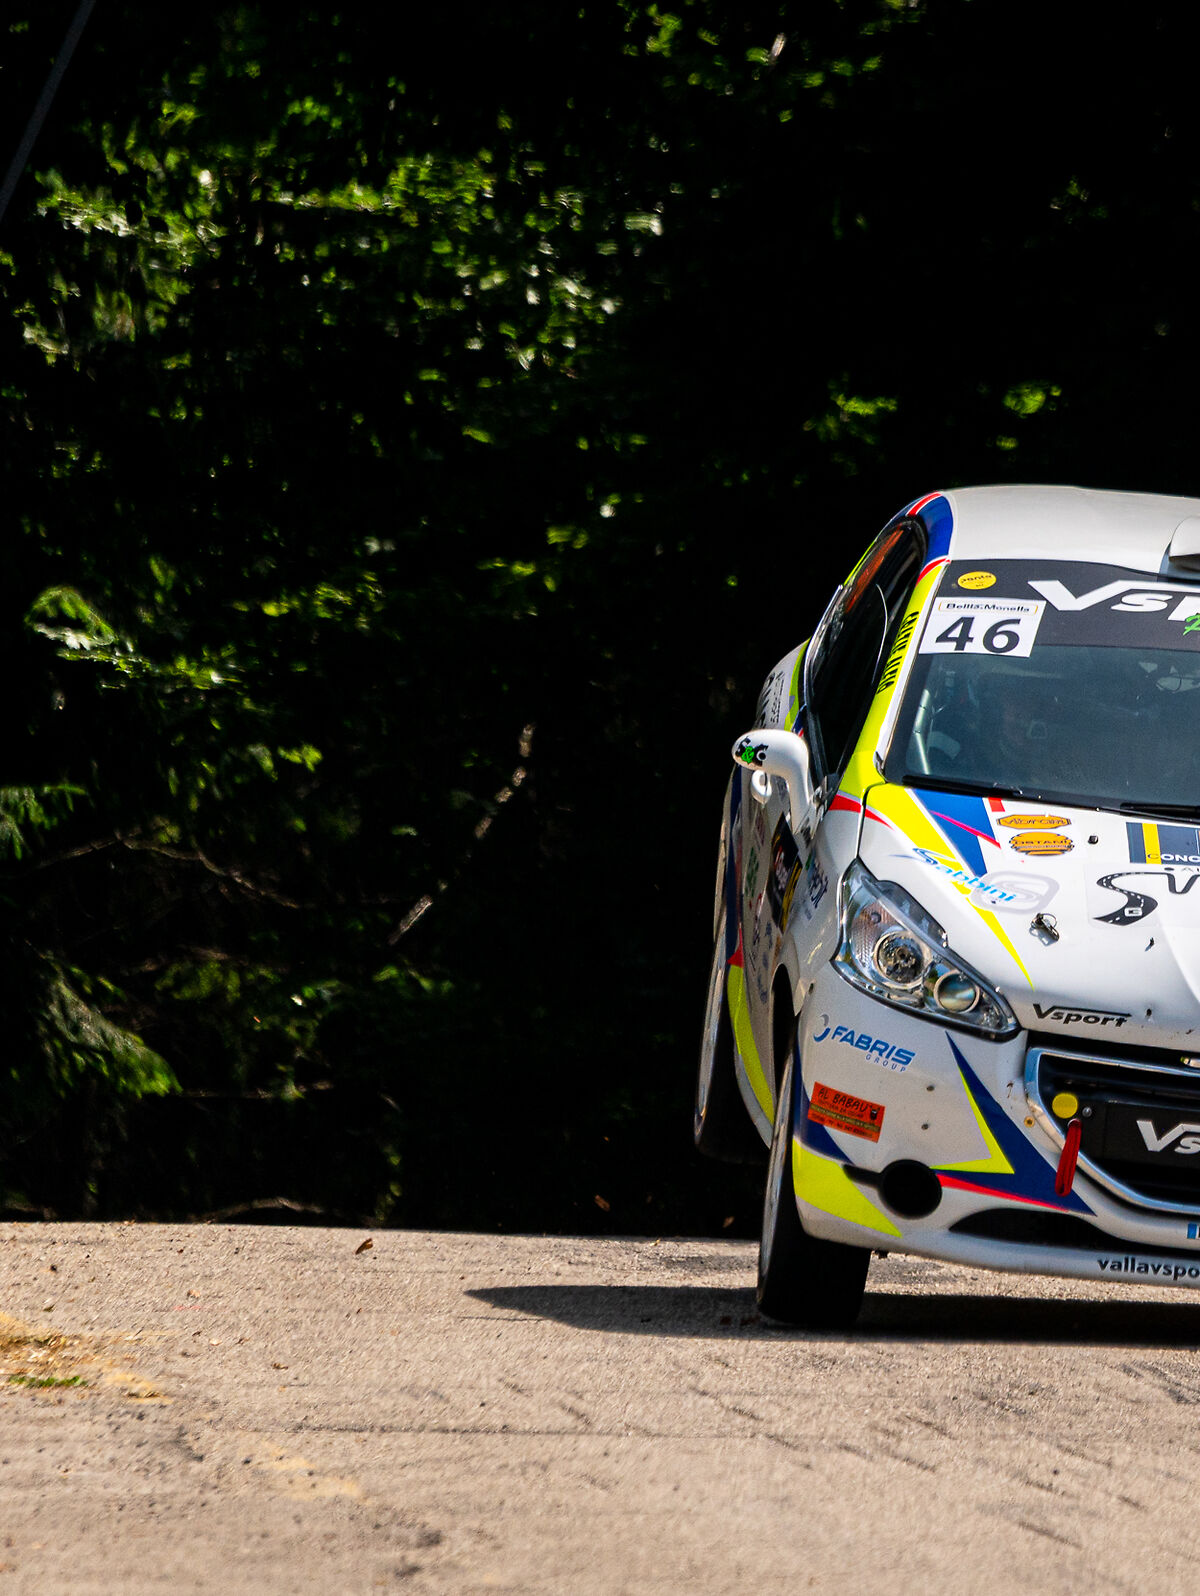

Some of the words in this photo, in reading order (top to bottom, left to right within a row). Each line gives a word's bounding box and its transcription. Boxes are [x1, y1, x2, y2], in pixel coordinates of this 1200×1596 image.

[935, 616, 1021, 654] 46
[1032, 1003, 1132, 1028] Vsport
[831, 1025, 916, 1066] FABRIS
[865, 1053, 907, 1072] GROUP
[818, 1087, 829, 1100] AL
